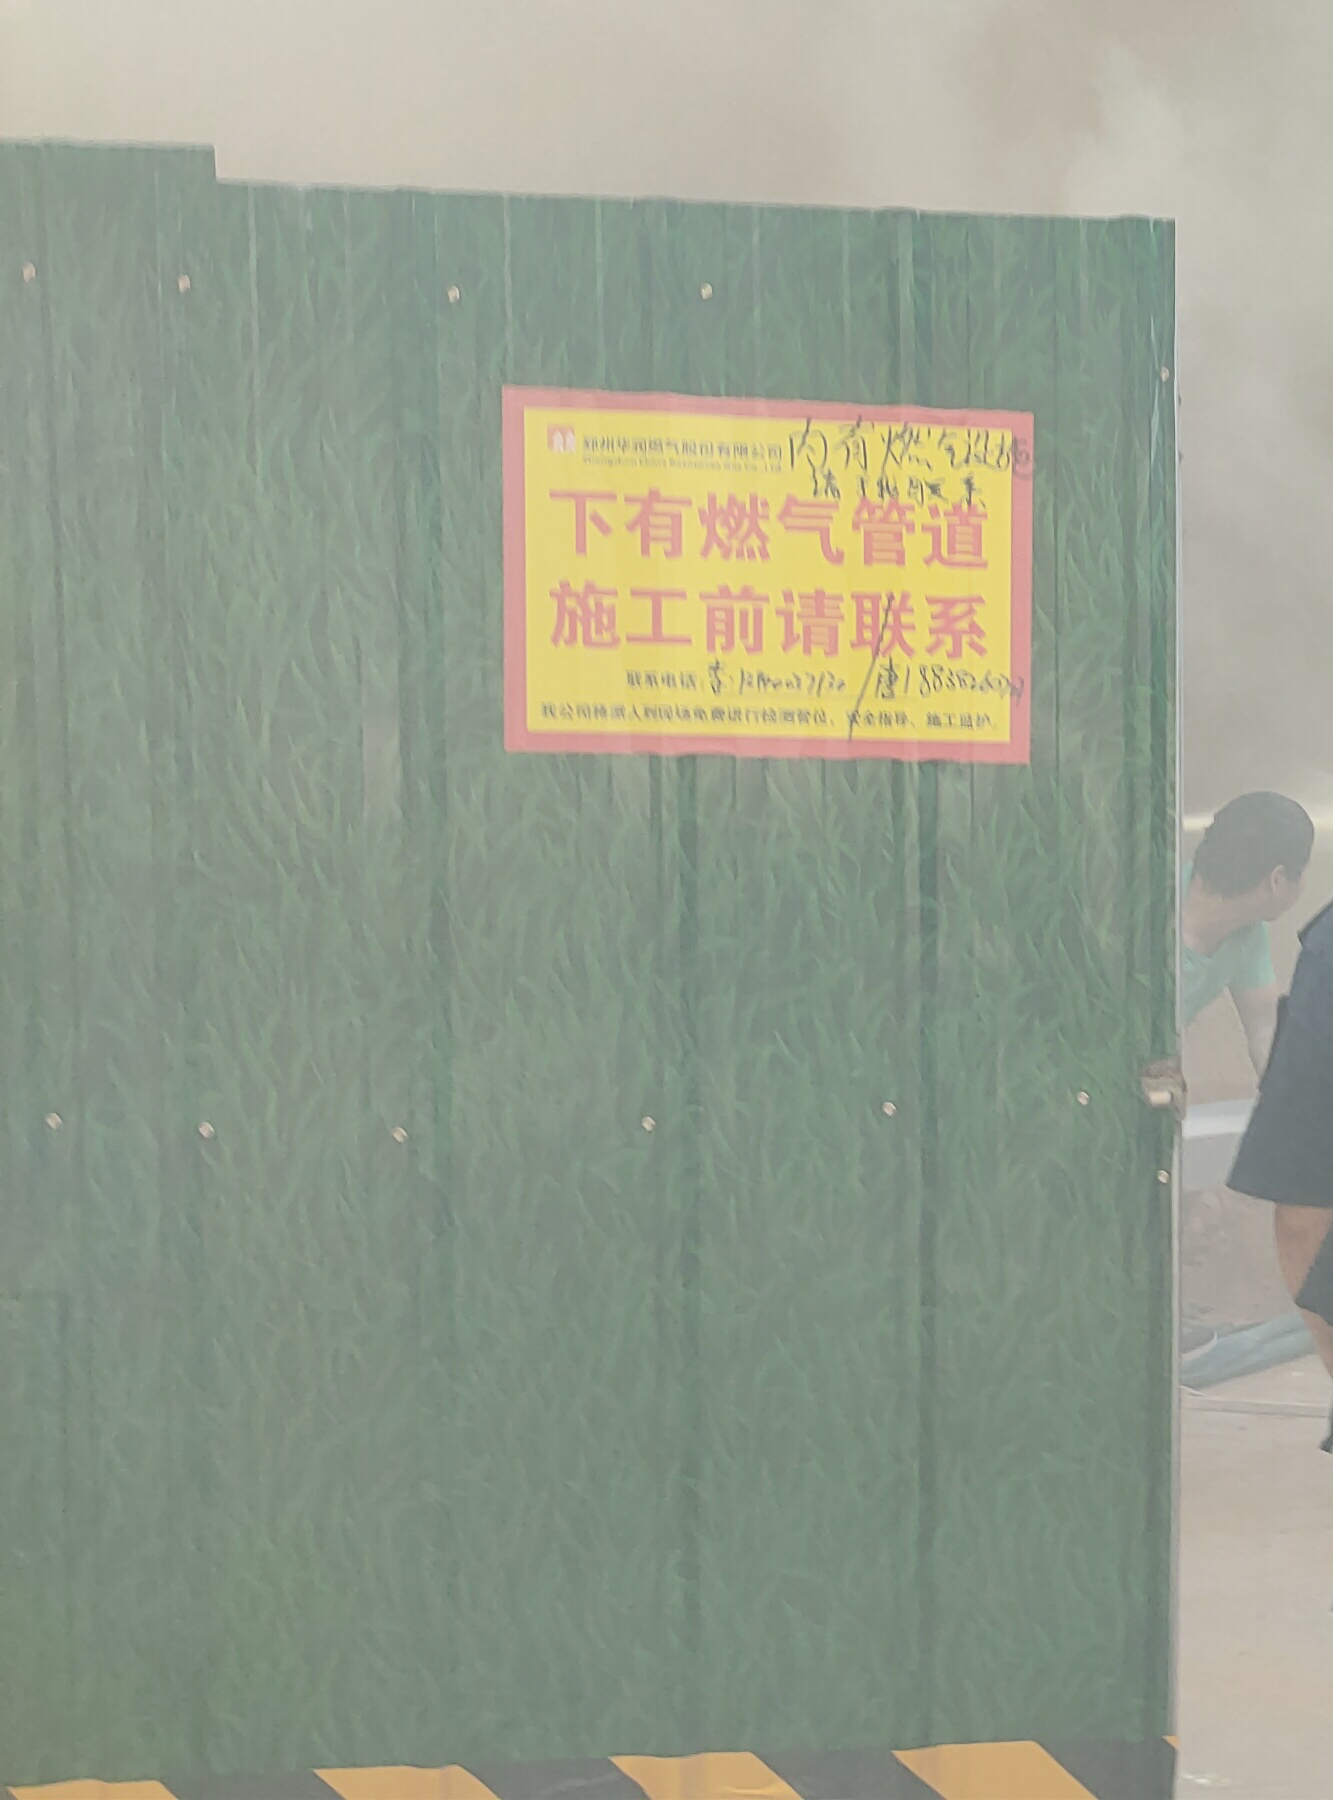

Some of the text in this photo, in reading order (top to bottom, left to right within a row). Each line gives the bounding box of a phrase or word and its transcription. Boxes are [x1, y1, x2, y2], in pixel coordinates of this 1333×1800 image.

[548, 486, 989, 570] 下有燃气管道
[549, 578, 989, 660] 施工前请联系
